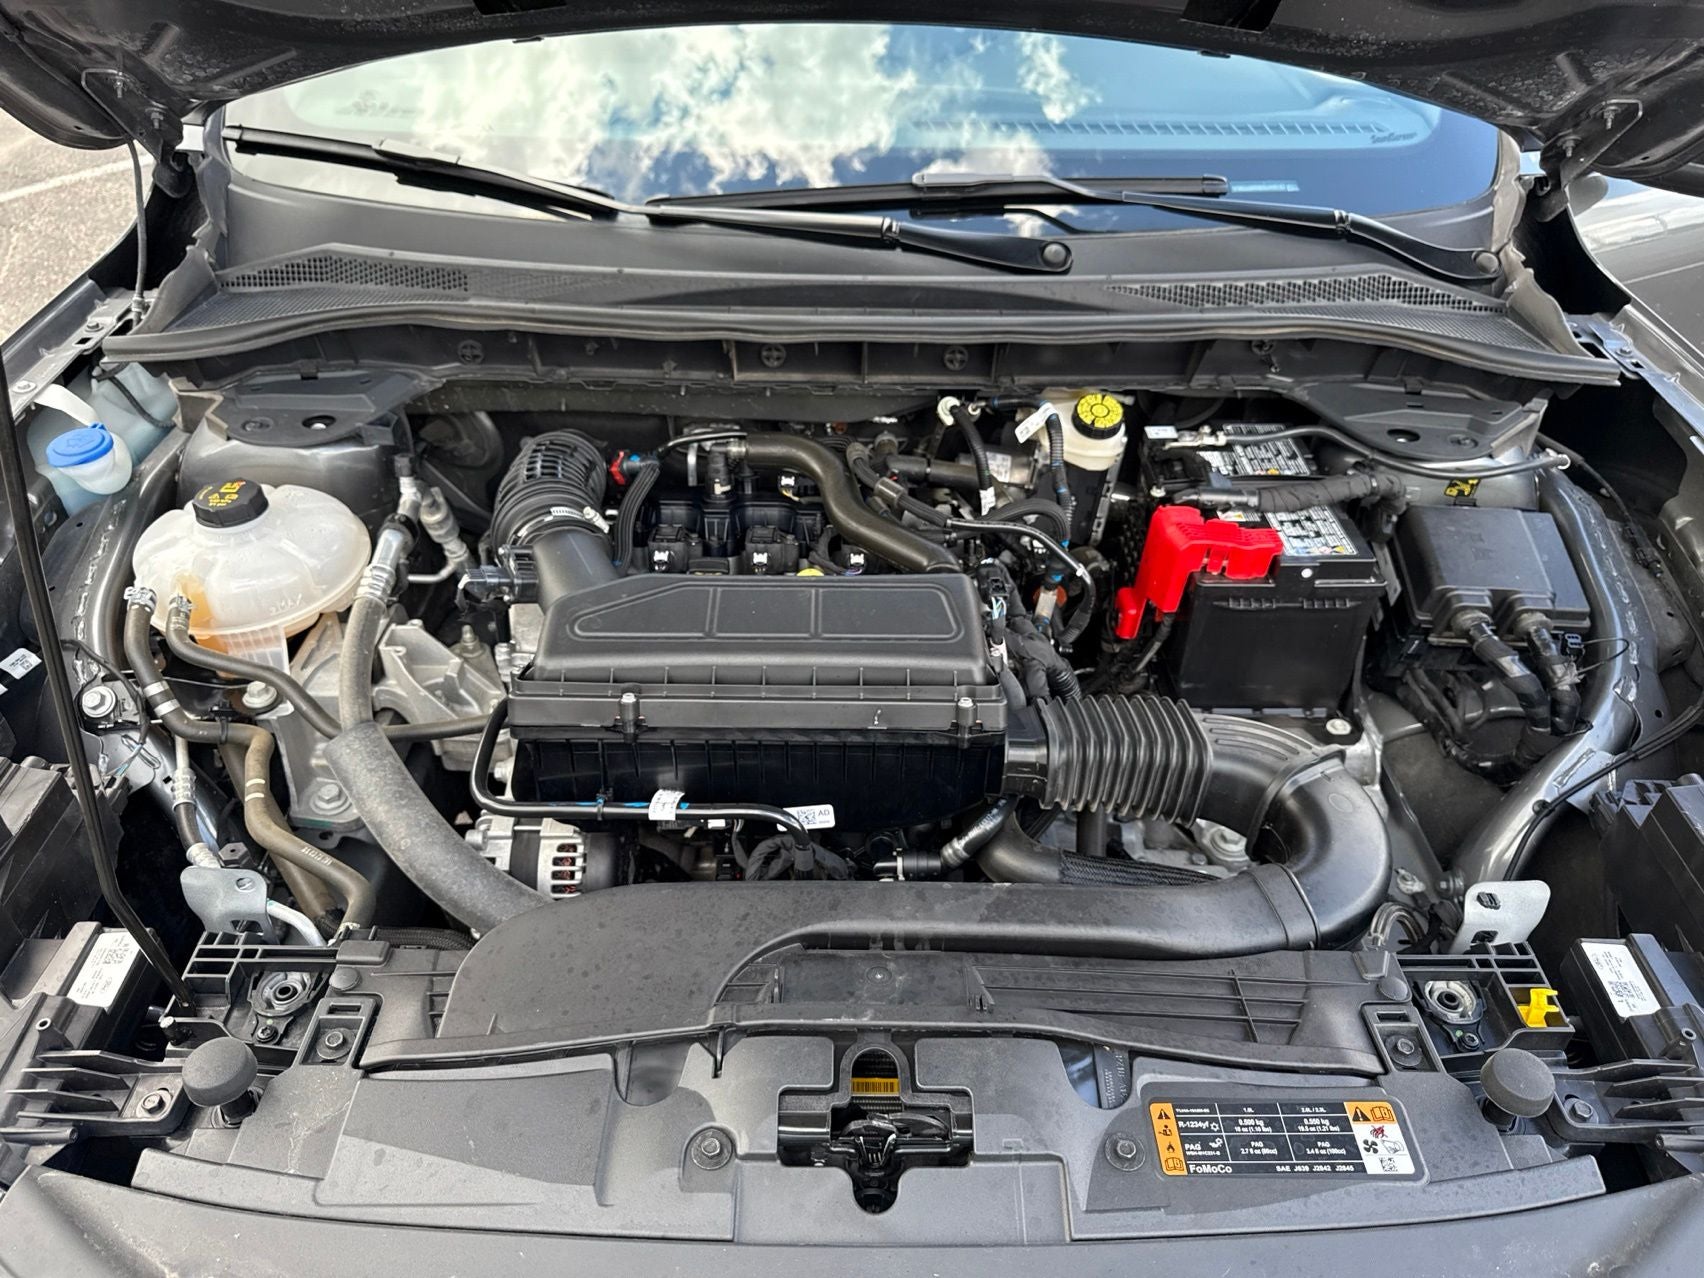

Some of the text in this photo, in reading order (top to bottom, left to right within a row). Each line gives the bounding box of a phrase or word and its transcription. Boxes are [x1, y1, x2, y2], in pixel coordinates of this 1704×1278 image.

[1178, 1120, 1209, 1130] R-1234yf
[1184, 1143, 1202, 1151] PAG
[1189, 1164, 1232, 1173] FoMoCo
